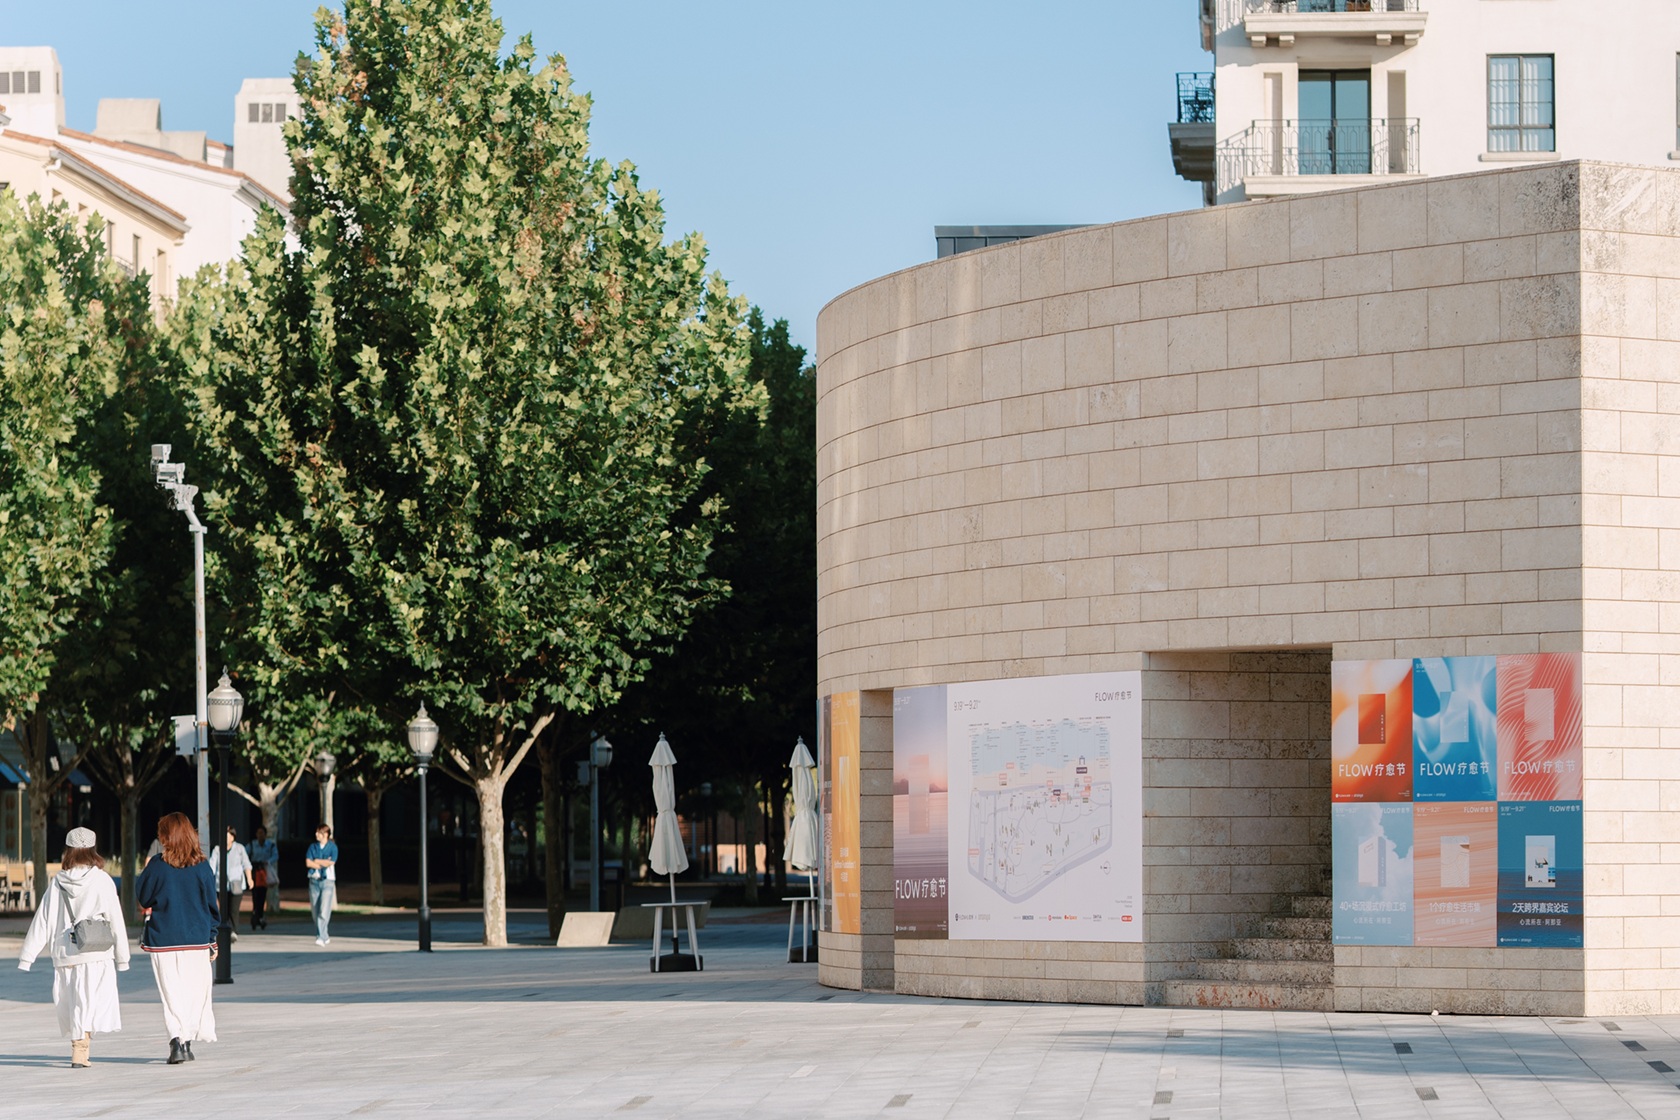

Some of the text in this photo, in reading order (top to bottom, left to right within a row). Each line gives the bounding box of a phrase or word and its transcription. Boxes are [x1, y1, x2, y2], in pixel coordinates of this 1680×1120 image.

[1338, 762, 1406, 777] FLOW疗愈节
[1420, 761, 1490, 776] FLOW疗愈节
[1504, 760, 1576, 774] FLOW疗愈节
[895, 877, 946, 899] FLOW疗愈节
[1512, 902, 1569, 913] 2天跨界嘉宾论坛
